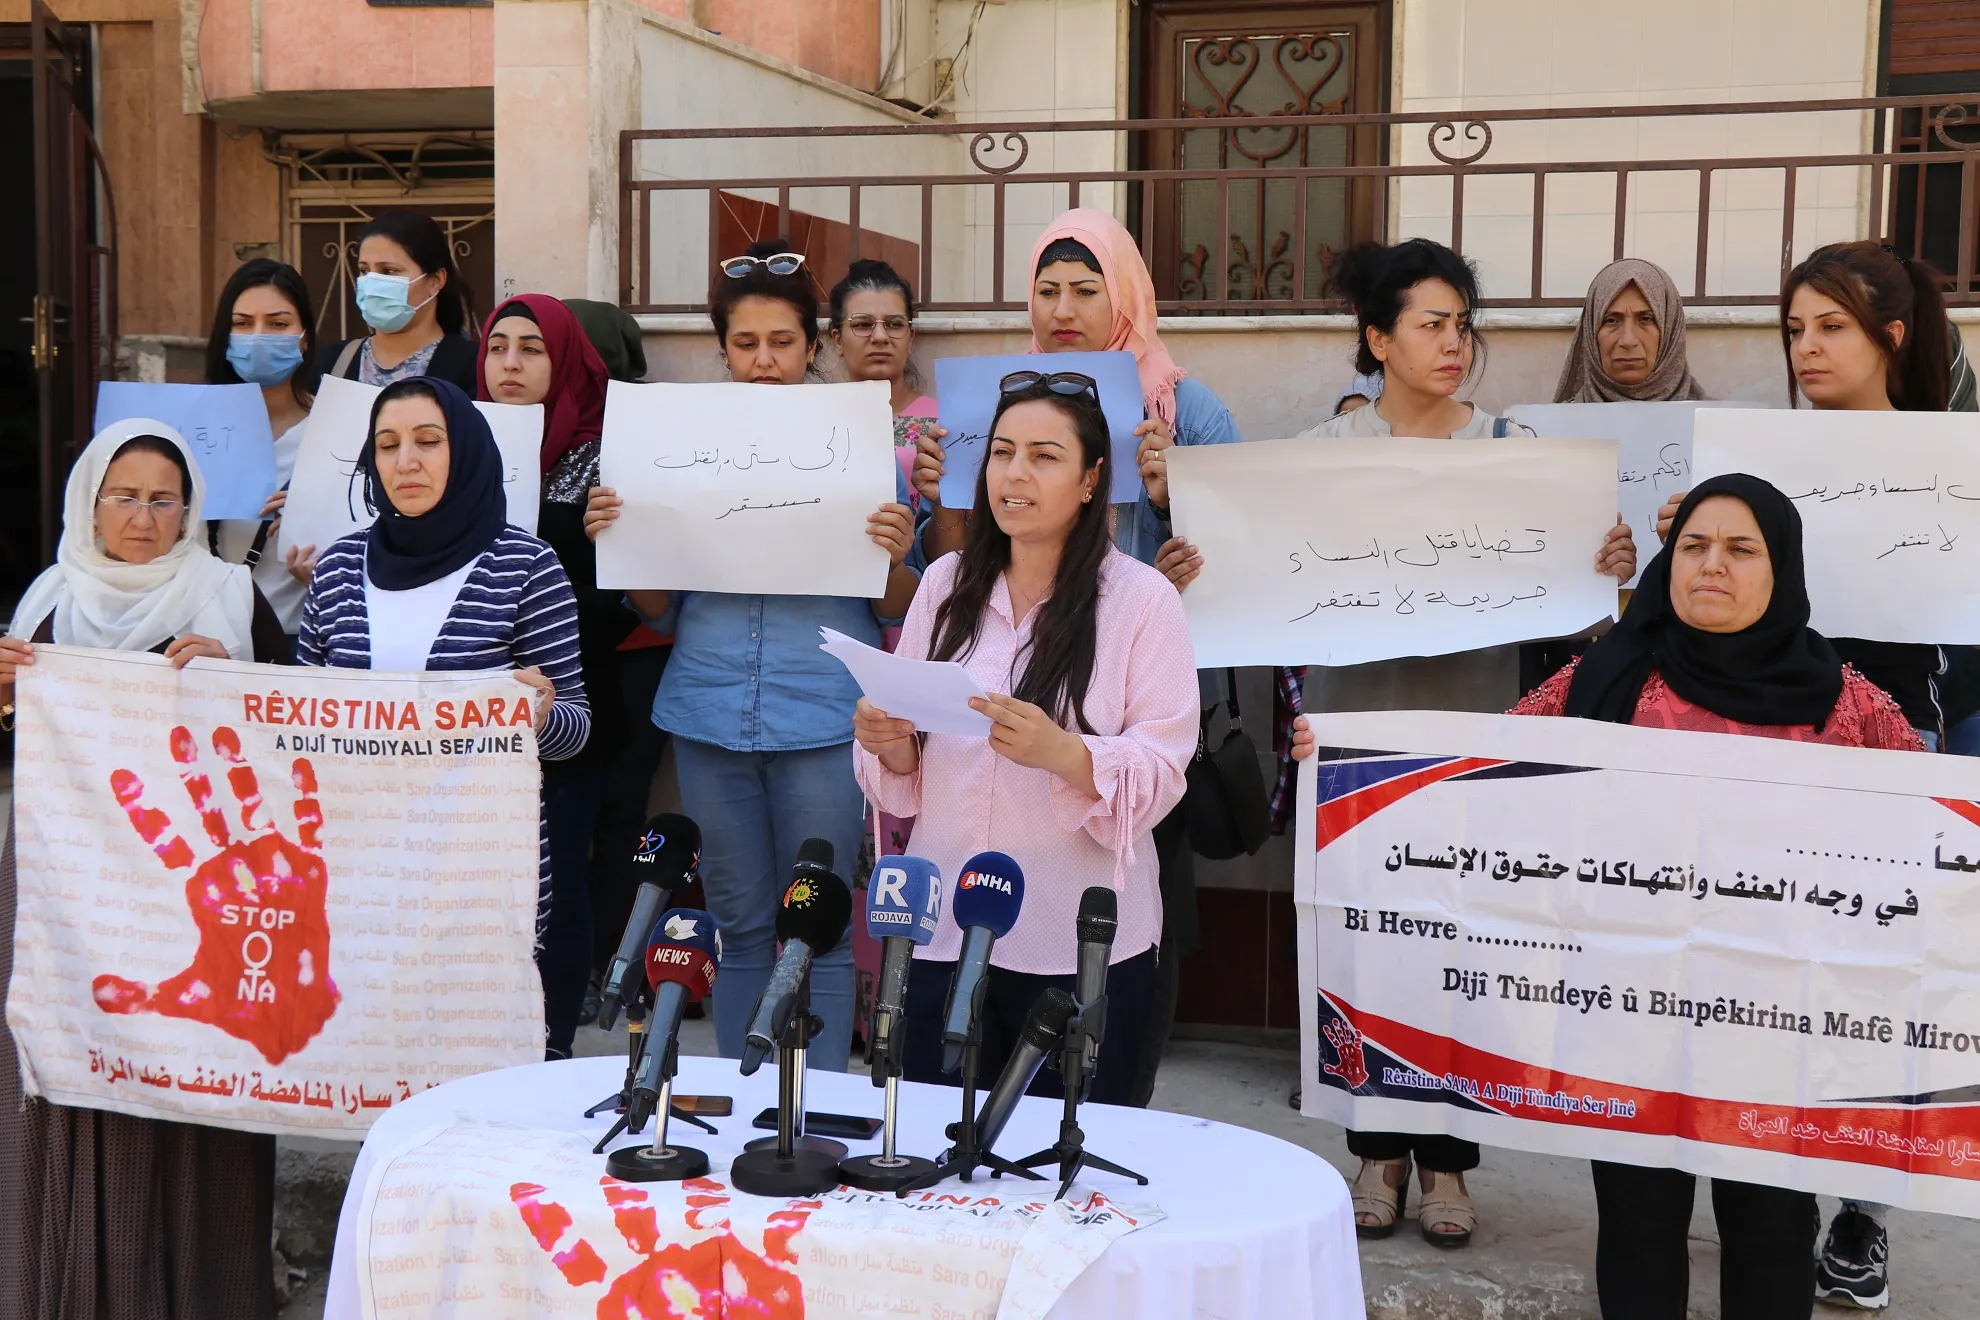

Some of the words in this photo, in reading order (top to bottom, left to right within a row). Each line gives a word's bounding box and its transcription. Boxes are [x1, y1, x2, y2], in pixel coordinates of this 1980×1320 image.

[789, 426, 850, 472] إلى
[1789, 482, 1865, 503] جريم
[715, 497, 821, 519] مستمر
[1462, 524, 1546, 561] قضايا
[1939, 523, 1958, 551] لا
[1289, 537, 1390, 574] النساء
[1394, 533, 1458, 567] قتل
[1395, 583, 1415, 615] لا
[244, 690, 420, 731] RÊXISTINA
[435, 697, 533, 731] SARA
[276, 734, 287, 750] A
[292, 733, 325, 753] DIJÎ
[333, 738, 432, 756] TUNDIYALI
[407, 783, 431, 796] Sara
[433, 782, 496, 798] Organization
[407, 810, 427, 823] Sara
[429, 809, 498, 827] Organization
[404, 840, 423, 852] Sara
[425, 838, 500, 855] Organization
[633, 853, 656, 863] اليوم
[1385, 842, 1487, 880] الإنسان
[1492, 850, 1569, 883] حقوق
[400, 867, 420, 881] Sara
[423, 867, 501, 886] Organization
[875, 867, 909, 908] R
[965, 873, 1012, 896] ANHA
[1576, 857, 1708, 900] وأنتهاكات
[1714, 870, 1796, 903] العنف
[397, 896, 418, 910] Sara
[422, 896, 502, 914] Organization
[1804, 884, 1863, 917] وجه
[1875, 887, 1918, 927] في
[220, 903, 296, 930] STOP
[871, 912, 911, 924] ROJAVA
[1344, 906, 1369, 933] Bi
[1379, 910, 1458, 940] Hevre
[123, 925, 183, 945] Organizat
[395, 923, 417, 937] Sara
[421, 923, 502, 941] Organization
[392, 952, 417, 966] Sara
[421, 951, 504, 968] Organization
[654, 947, 692, 966] NEWS
[237, 977, 276, 1004] NA
[391, 980, 419, 995] Sara
[423, 979, 505, 996] Organization
[393, 1008, 422, 1022] Sara
[425, 1007, 506, 1024] Organization
[1443, 967, 1489, 1001] Dijî
[1497, 973, 1612, 1014] Tûndeyê
[1622, 986, 1639, 1013] û
[1648, 990, 1812, 1035] Binpêkirina
[1822, 1010, 1893, 1043] Mafê
[395, 1034, 423, 1048] Sara
[427, 1034, 506, 1051] Organization
[88, 1048, 134, 1084] المرأة
[140, 1064, 172, 1088] ضد
[177, 1067, 245, 1097] العنف
[250, 1071, 334, 1110] لمناهضة
[1383, 1067, 1444, 1090] Rêxistina
[1445, 1073, 1479, 1097] SARA
[1483, 1085, 1494, 1099] A
[1497, 1085, 1523, 1105] Dijî
[1525, 1090, 1579, 1114] Tûndiya
[1582, 1096, 1605, 1114] Ser
[1607, 1098, 1635, 1118] Jinê
[341, 1083, 392, 1115] سارا
[1738, 1109, 1788, 1139] المرأة
[1790, 1122, 1820, 1140] ضد
[1823, 1127, 1873, 1146] العنف
[1877, 1130, 1944, 1157] لمناهضة
[381, 1181, 424, 1200] ization
[375, 1213, 420, 1236] ization
[935, 1229, 973, 1248] Sara
[372, 1251, 426, 1275] ization
[932, 1262, 970, 1283] Sara
[378, 1287, 432, 1310] ization
